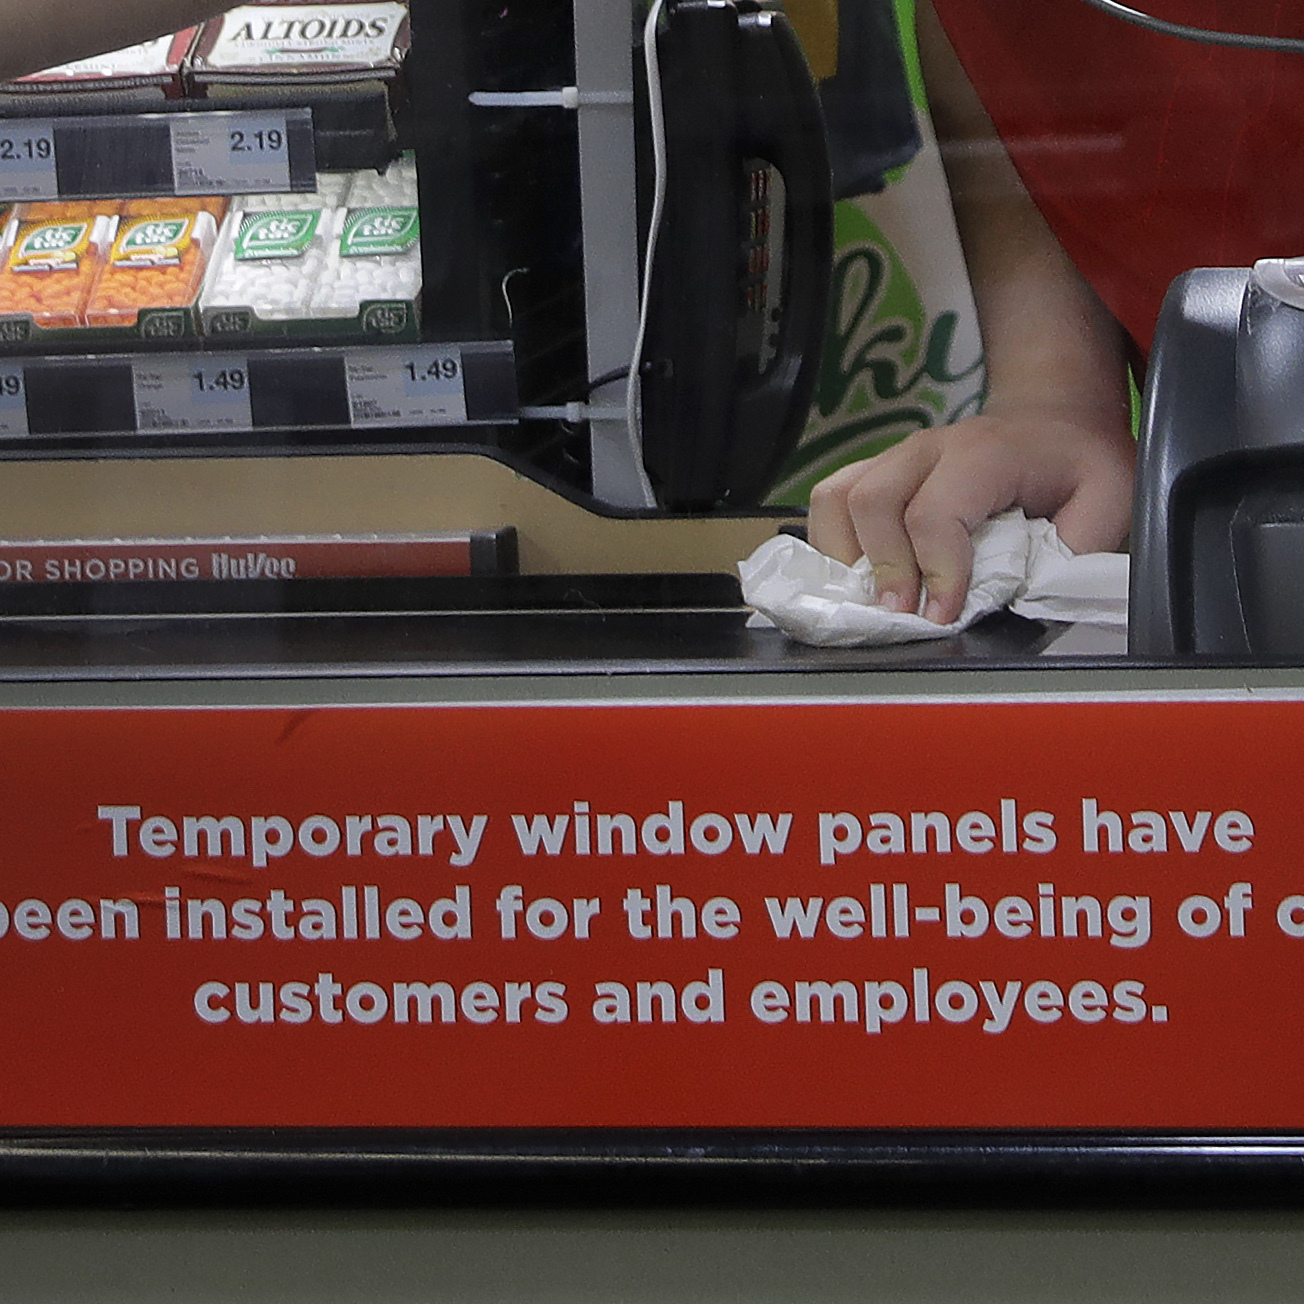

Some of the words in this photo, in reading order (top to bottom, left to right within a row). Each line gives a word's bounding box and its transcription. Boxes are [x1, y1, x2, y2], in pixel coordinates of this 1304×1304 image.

[231, 15, 390, 41] ALTOIDS
[229, 129, 283, 152] 2.19
[192, 368, 246, 392] 1.49
[404, 358, 459, 382] 1.49
[45, 557, 200, 581] SHOPPING
[98, 806, 487, 867] Temporary
[511, 801, 792, 855] window
[819, 799, 1056, 864] panels
[1083, 798, 1254, 853] have
[165, 884, 471, 939] installed
[496, 886, 599, 939] for
[623, 885, 740, 938] the
[765, 884, 1150, 948] well-being
[1178, 883, 1252, 937] of
[194, 973, 567, 1023] customers
[593, 969, 724, 1022] and
[751, 968, 1167, 1033] employees.
